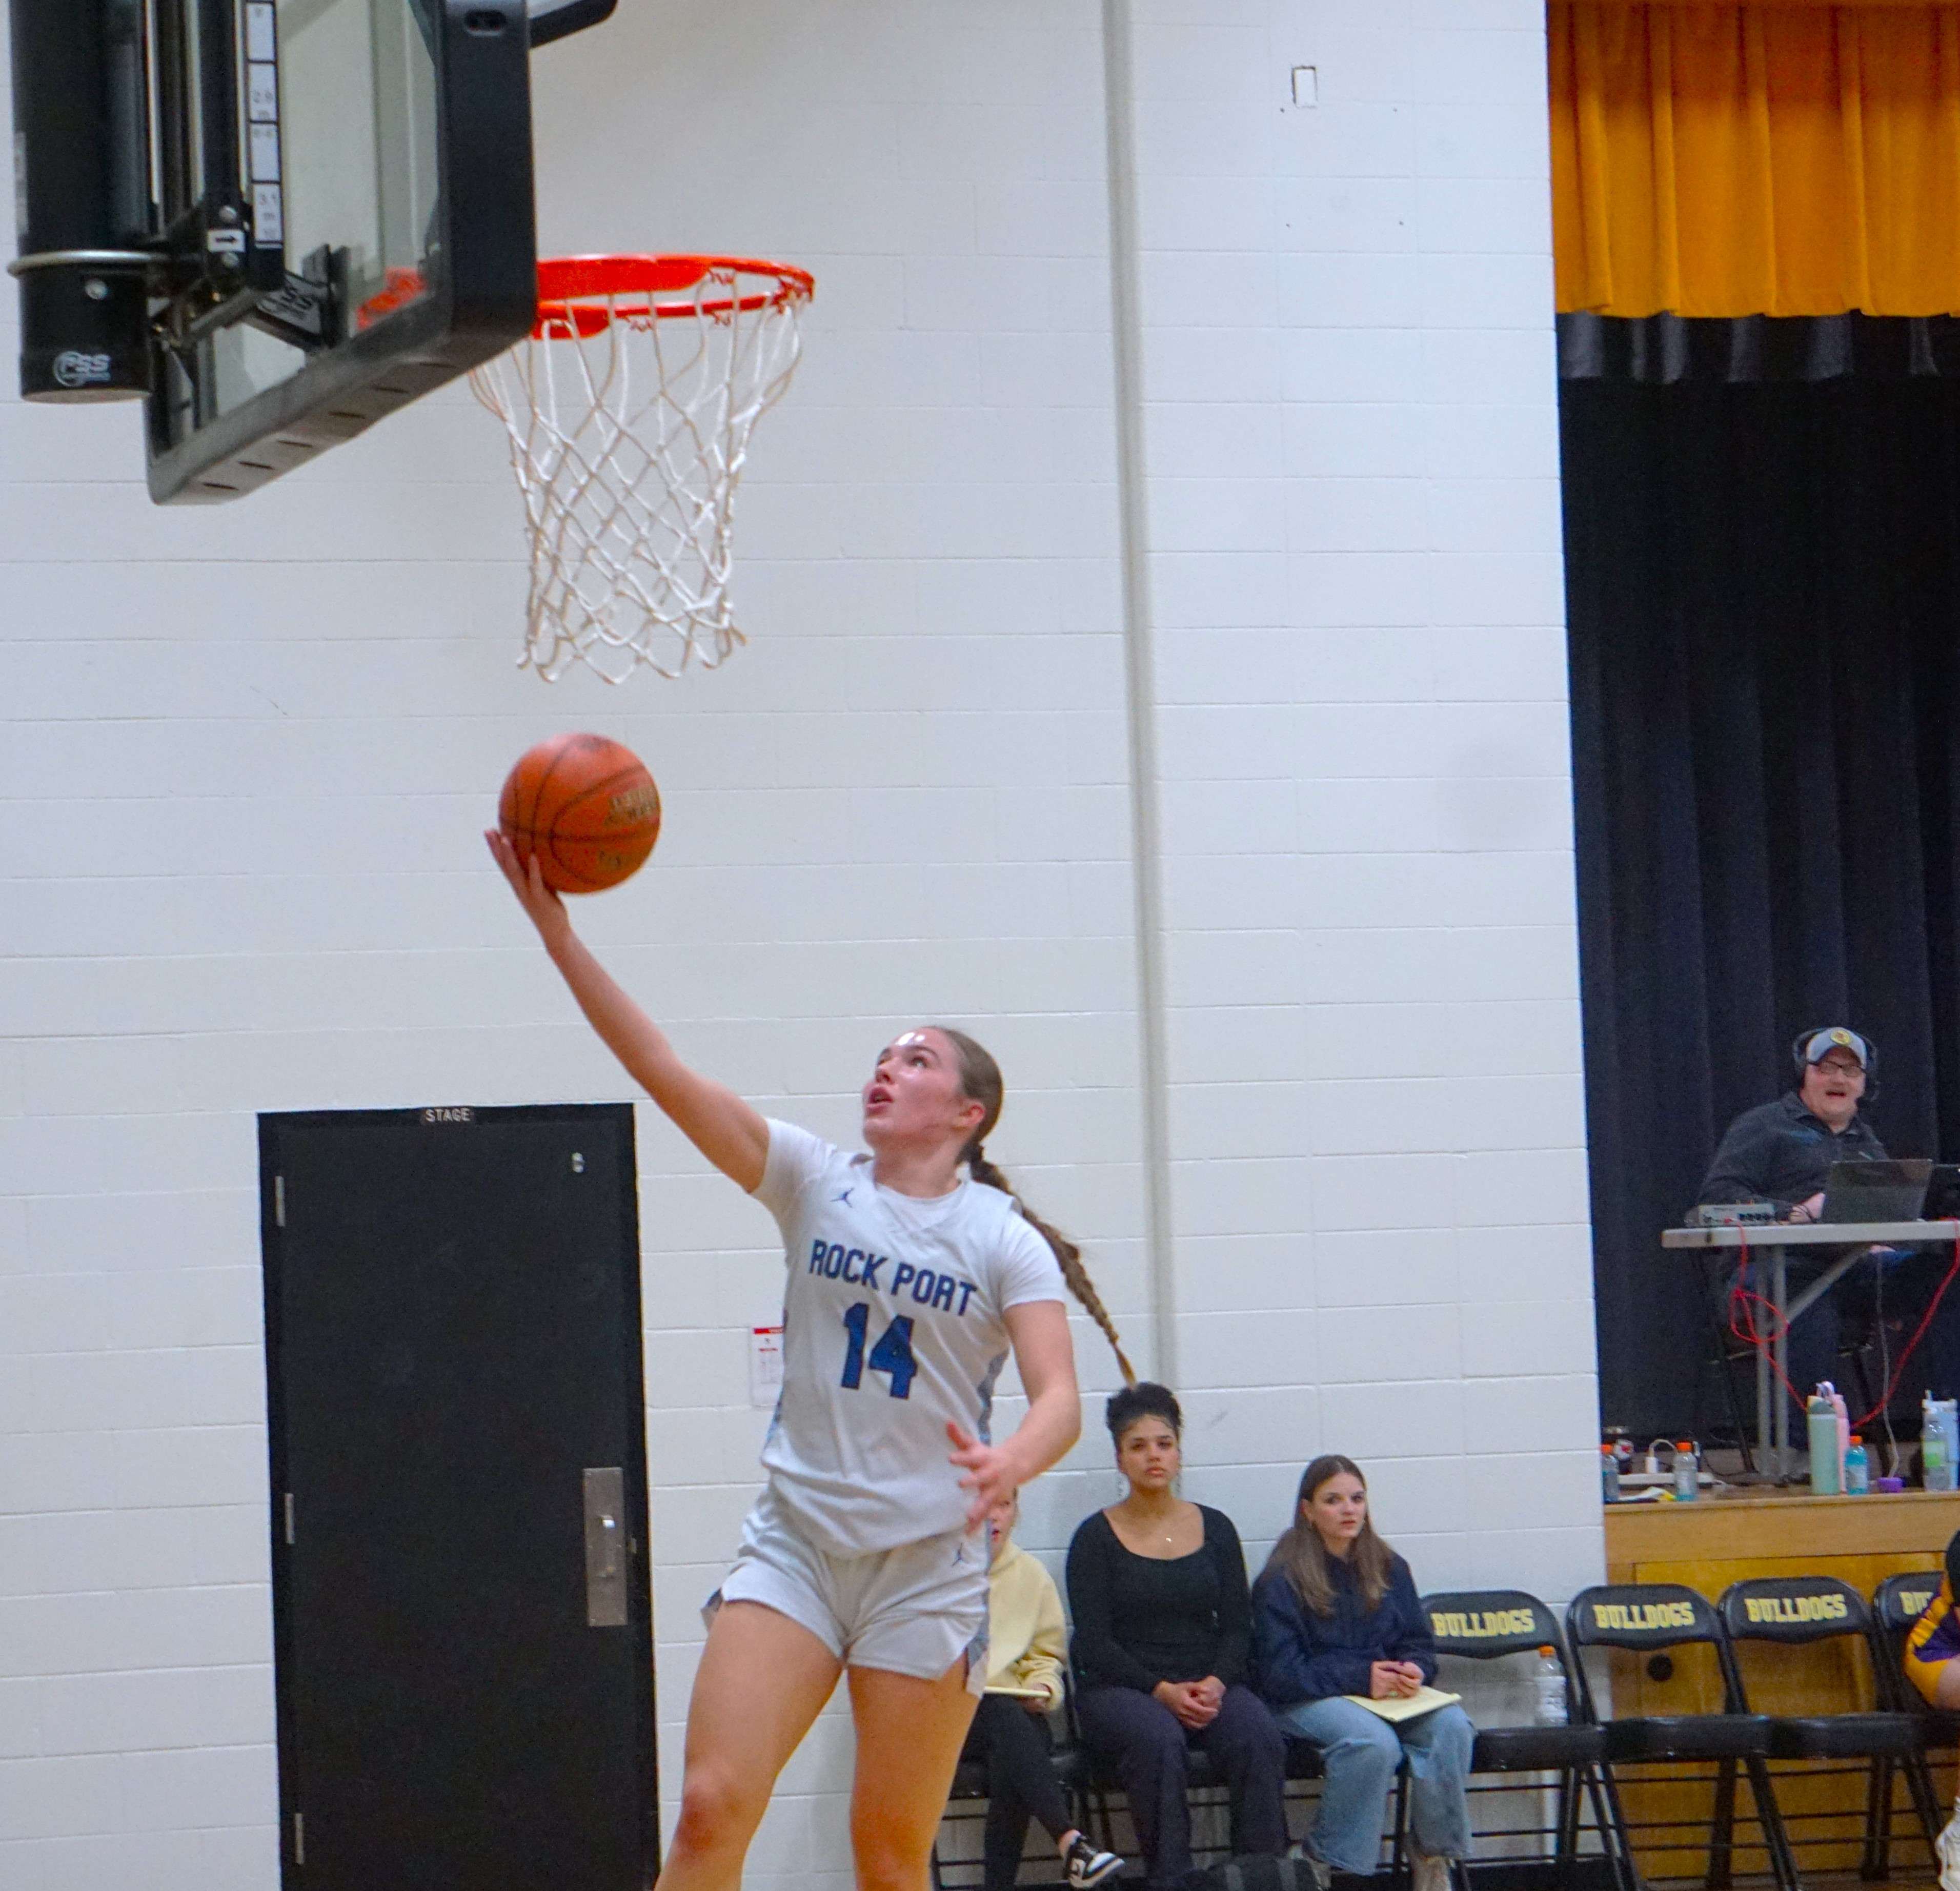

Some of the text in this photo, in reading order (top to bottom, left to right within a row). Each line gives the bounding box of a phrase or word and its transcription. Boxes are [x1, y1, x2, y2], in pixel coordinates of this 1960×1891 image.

[425, 1107, 471, 1122] STAGE
[809, 1239, 978, 1316] ROCK PORT
[841, 1302, 918, 1400] 14
[1592, 1601, 1695, 1629] BULLDOGS
[1744, 1593, 1848, 1622] BULLDOGS
[1430, 1608, 1535, 1637] BULLDOGS
